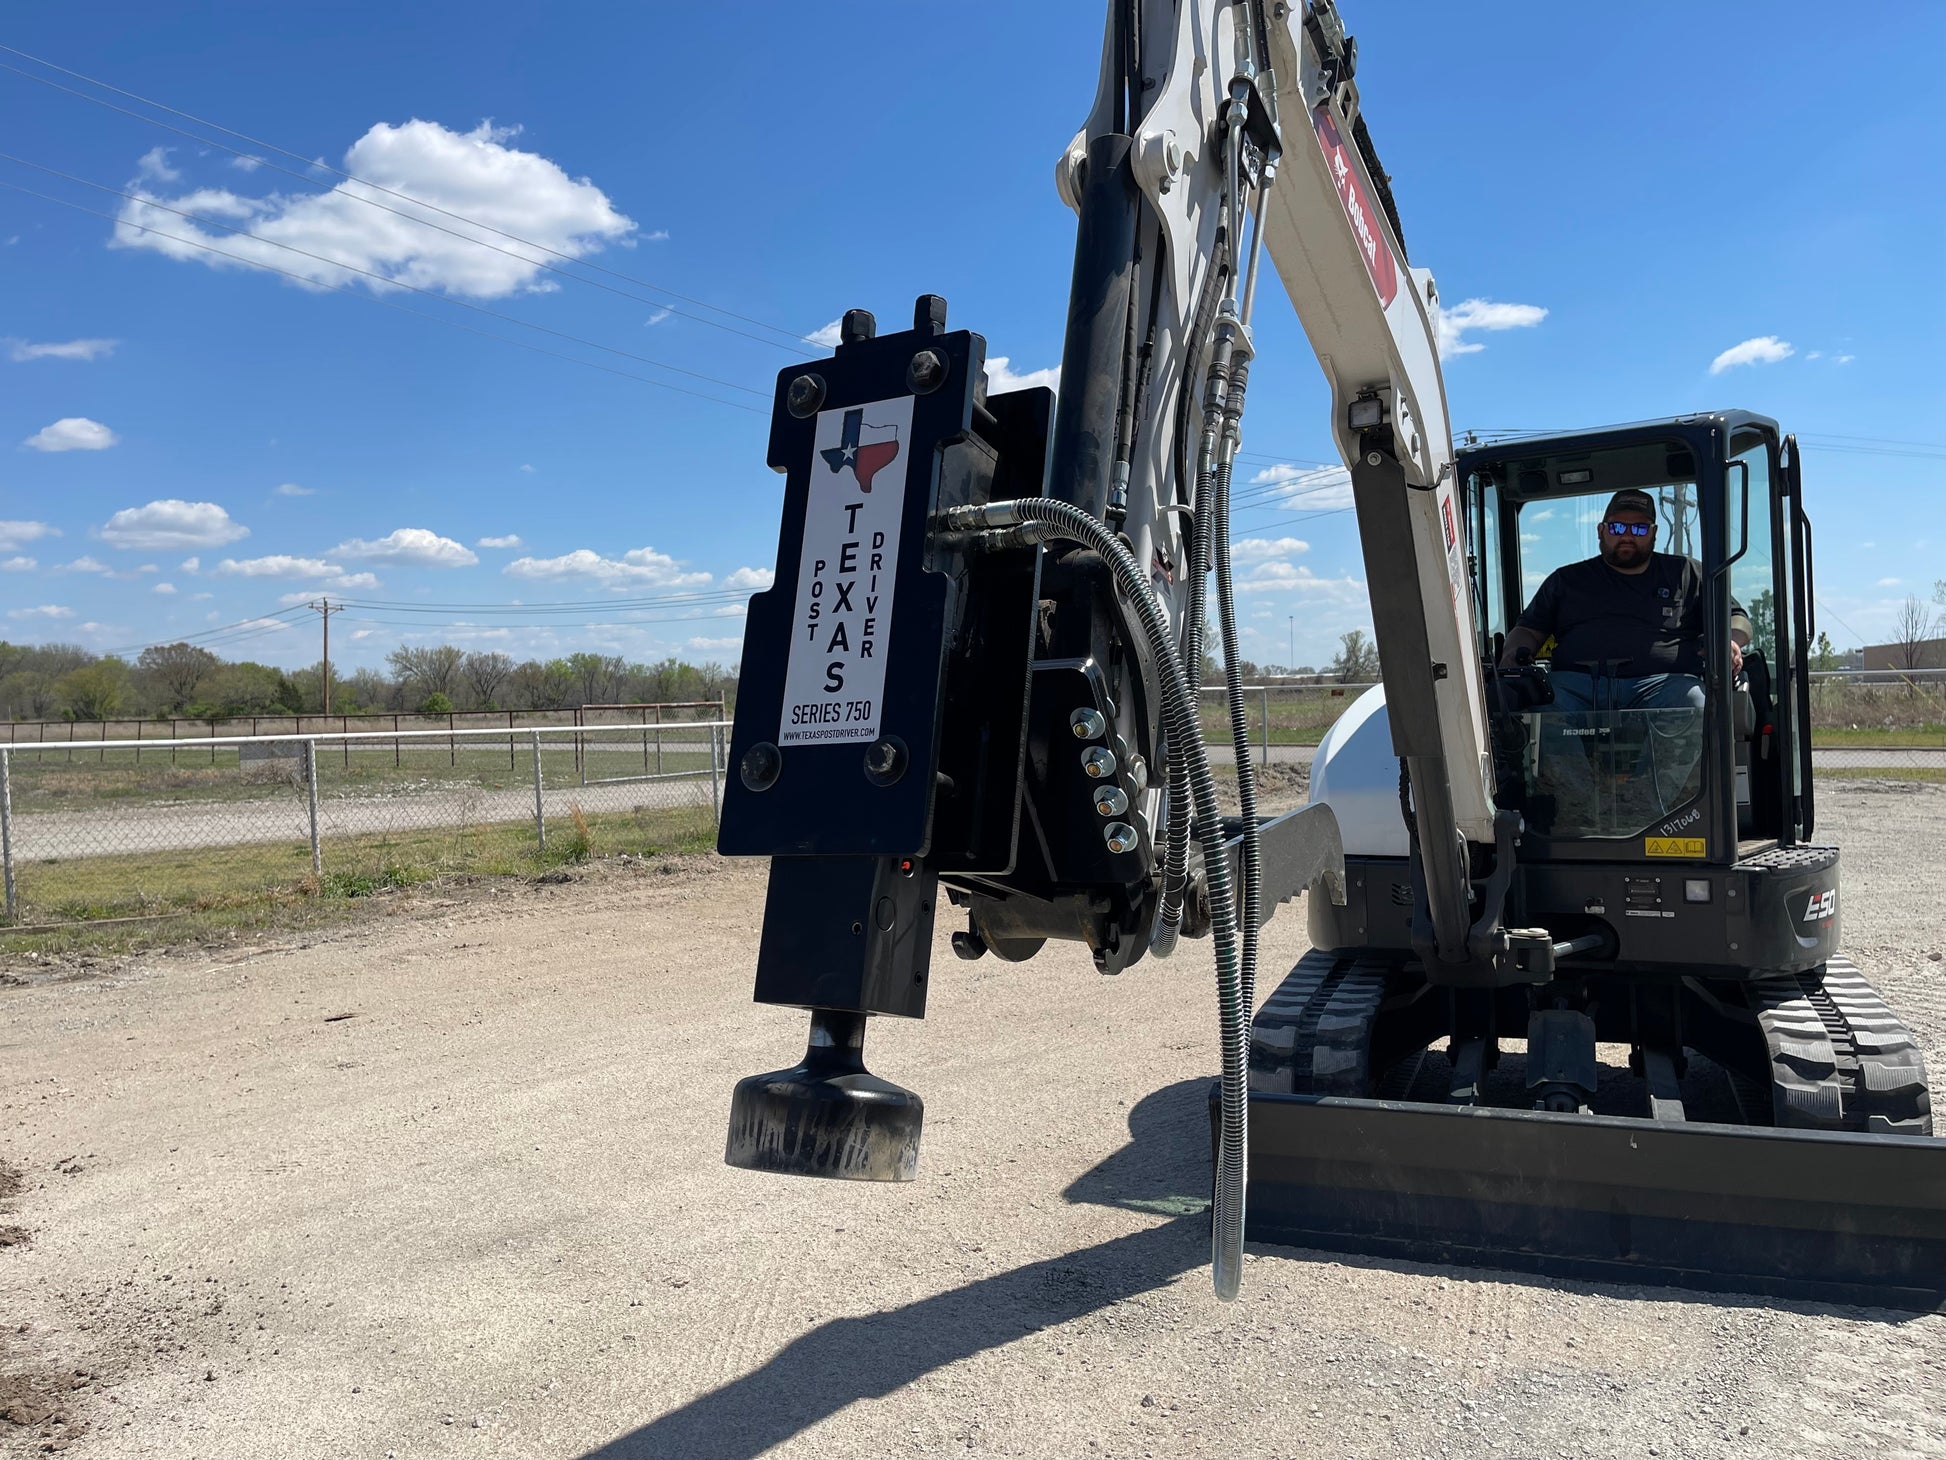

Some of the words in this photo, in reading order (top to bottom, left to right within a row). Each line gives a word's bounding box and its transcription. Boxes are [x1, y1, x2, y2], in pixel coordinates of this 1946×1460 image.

[1348, 183, 1376, 268] Bobcat
[808, 559, 826, 641] POST
[823, 502, 864, 693] TEXAS
[860, 531, 885, 658] DRIVER
[783, 727, 875, 741] WWW.TEXASPOSTDRIVER.COM
[791, 702, 842, 725] SERIES
[845, 700, 872, 722] 750
[1803, 888, 1836, 922] E50
